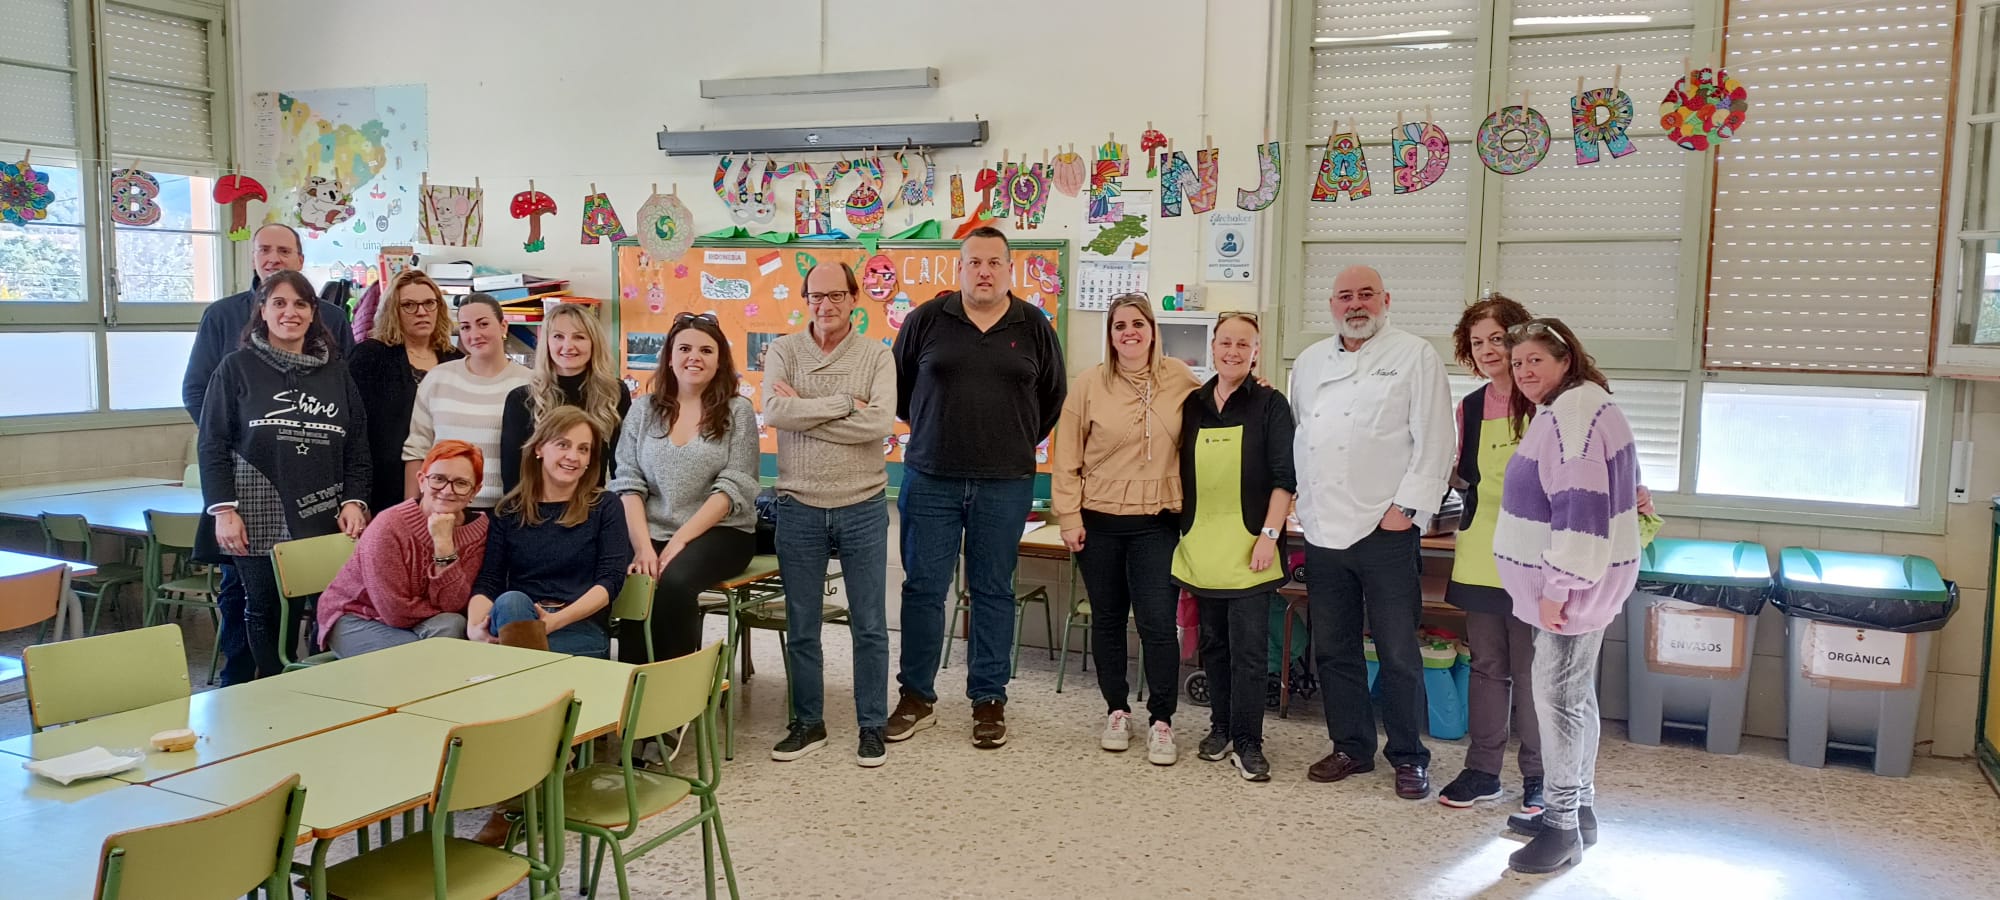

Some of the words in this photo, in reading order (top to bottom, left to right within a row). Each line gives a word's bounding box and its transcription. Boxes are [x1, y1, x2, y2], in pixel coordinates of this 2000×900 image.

[265, 389, 339, 418] Shine
[1670, 640, 1722, 653] ENVASOS
[1827, 651, 1891, 666] ORGÀNICA
